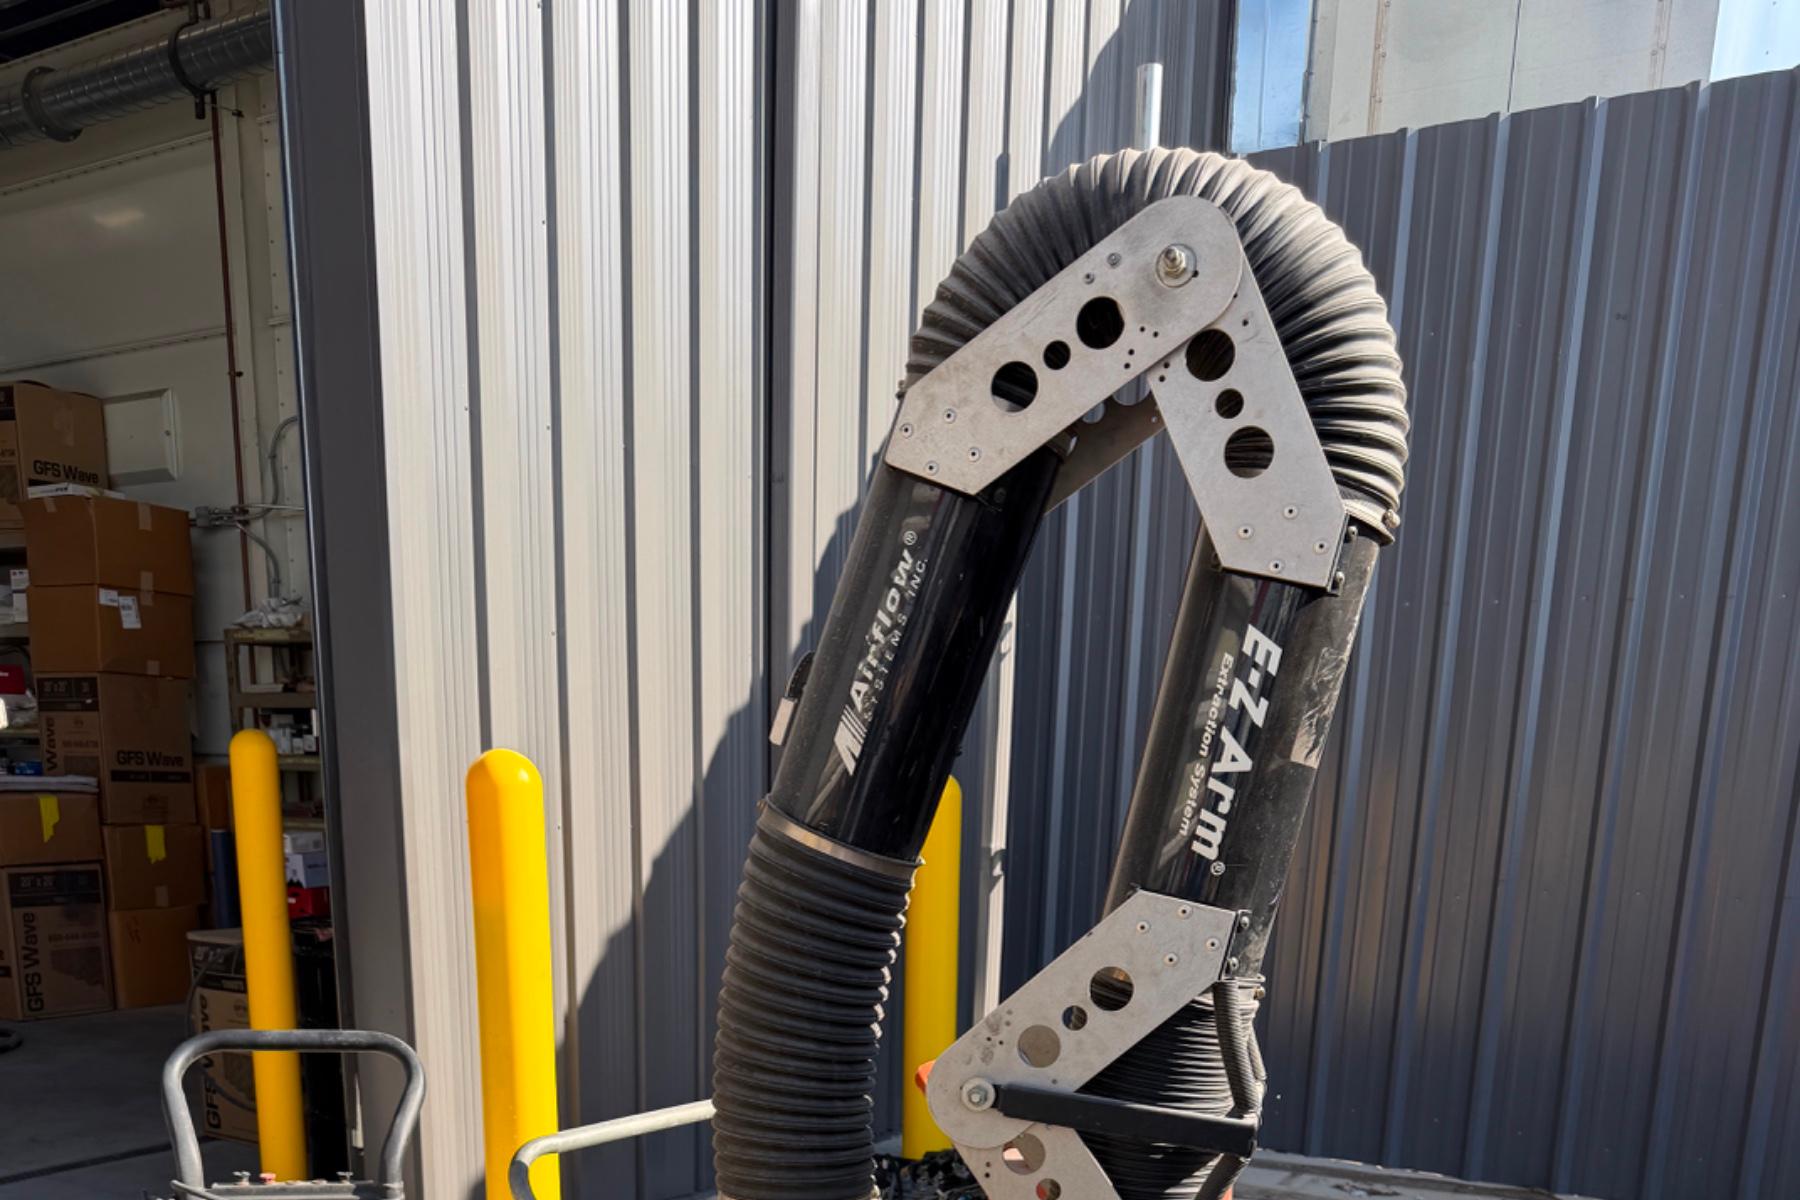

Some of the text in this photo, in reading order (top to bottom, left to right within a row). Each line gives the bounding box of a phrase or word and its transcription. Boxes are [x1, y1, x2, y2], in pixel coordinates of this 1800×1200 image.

[33, 459, 99, 483] GFS Wave
[863, 558, 928, 722] SYSTEMS INC.
[1228, 624, 1283, 728] E-Z
[116, 749, 184, 767] GFS Wave
[1179, 652, 1234, 836] Extraction System
[21, 912, 44, 1012] GFS Wave
